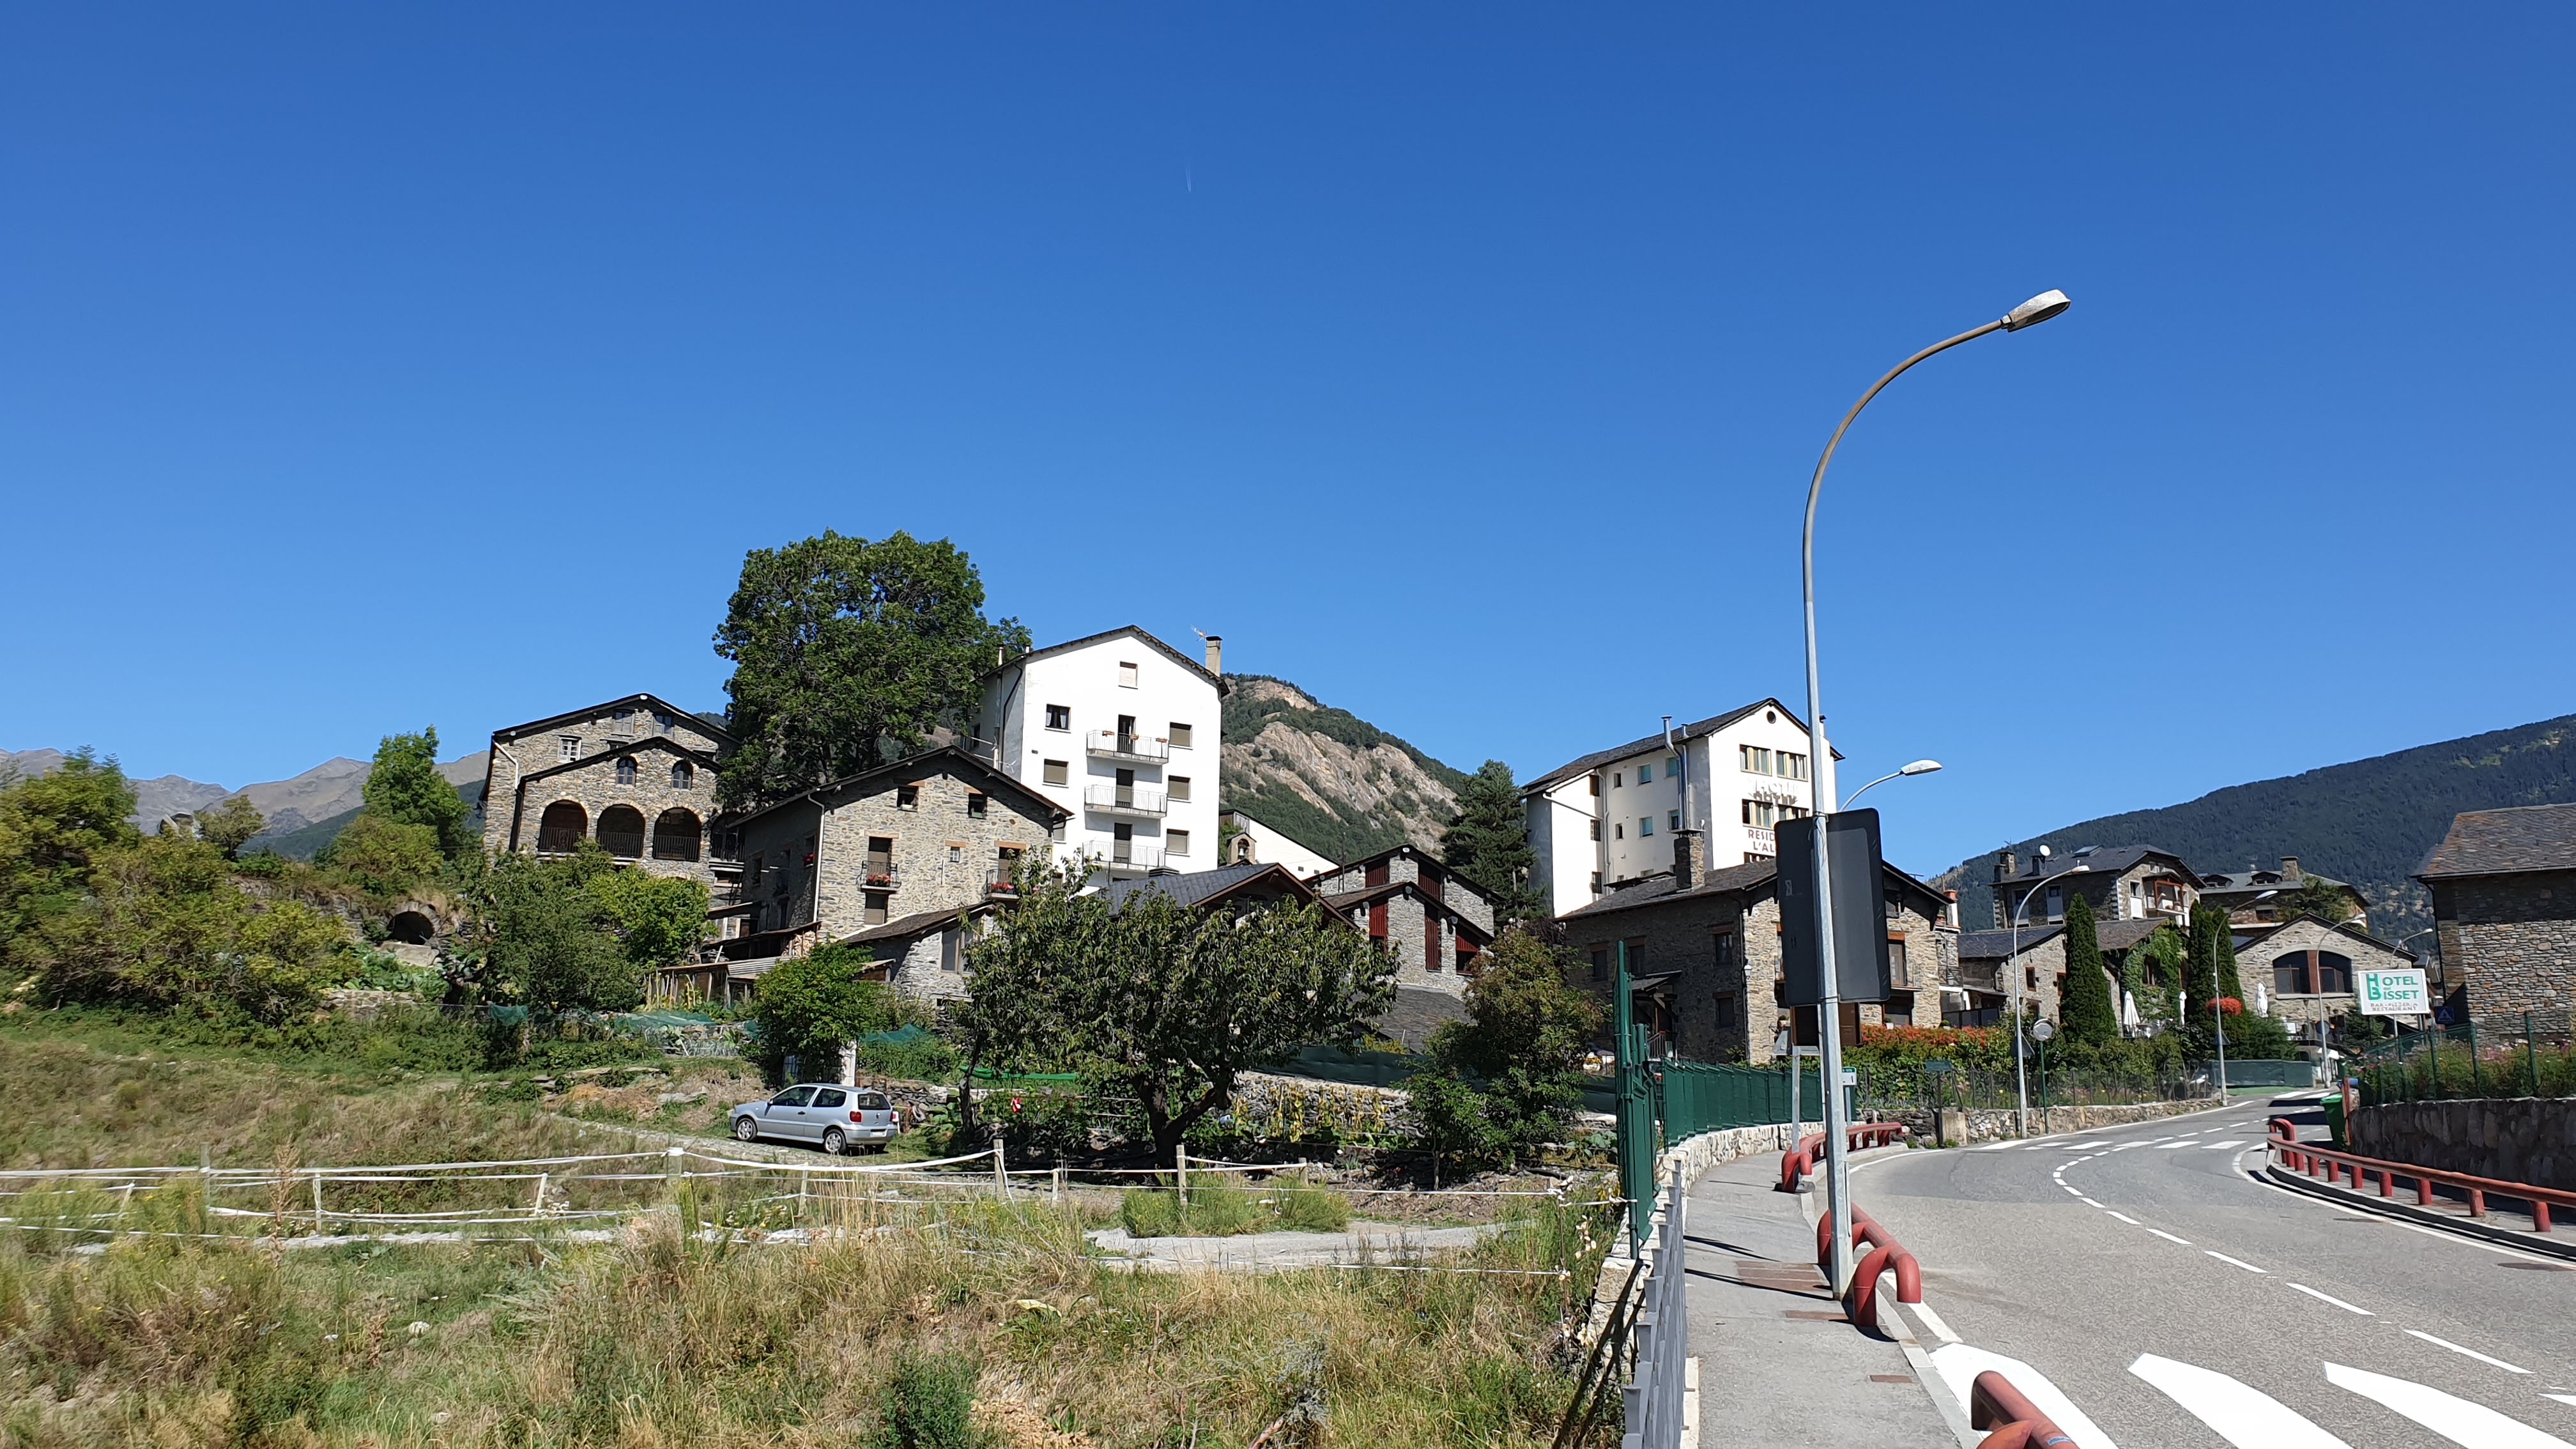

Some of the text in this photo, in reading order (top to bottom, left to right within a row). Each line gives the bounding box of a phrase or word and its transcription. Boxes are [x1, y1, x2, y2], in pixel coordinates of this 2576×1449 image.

[1748, 829, 1775, 841] RESID
[1753, 841, 1775, 853] L'AL
[2366, 973, 2418, 987] HOTEL
[2368, 987, 2419, 1000] BISSET
